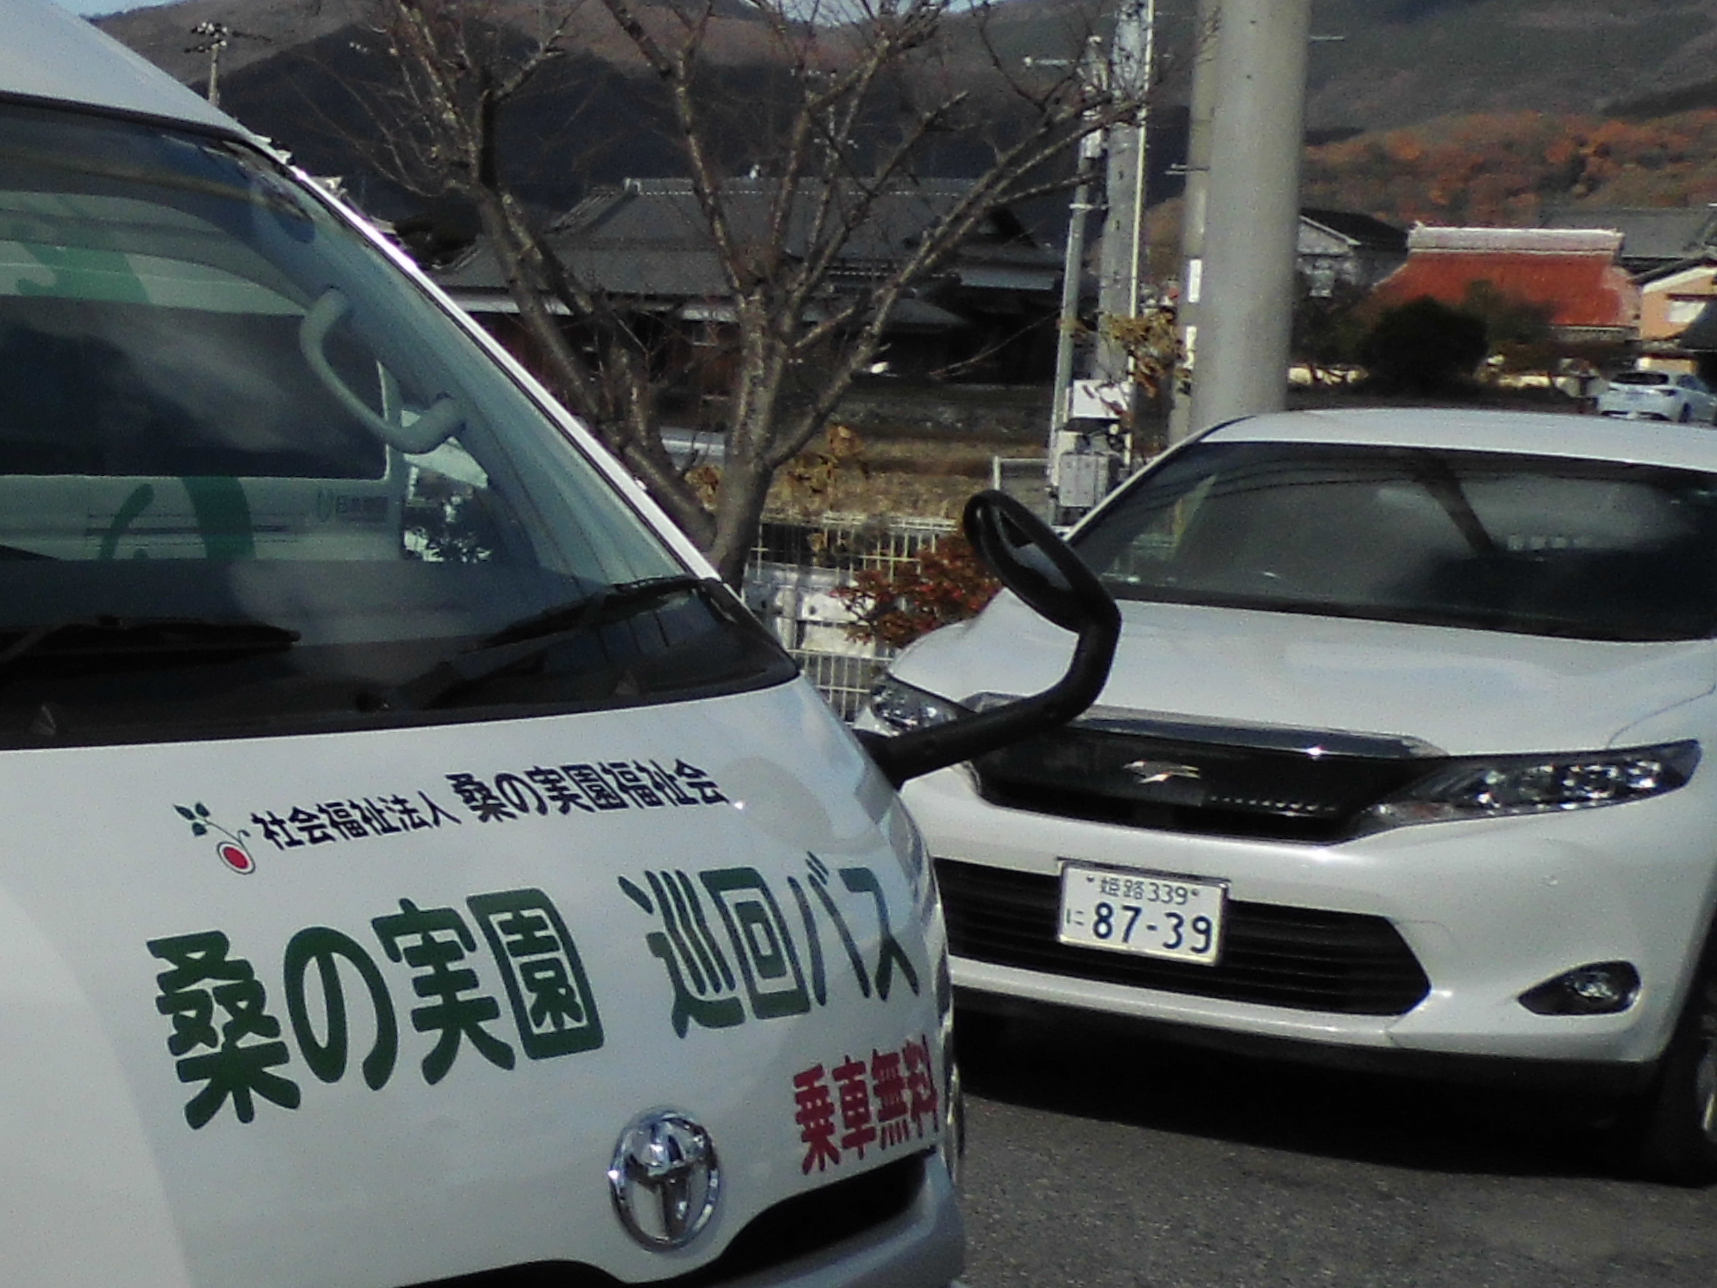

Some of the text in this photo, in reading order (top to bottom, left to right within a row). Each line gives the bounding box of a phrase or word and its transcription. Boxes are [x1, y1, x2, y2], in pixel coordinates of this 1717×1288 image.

[251, 758, 730, 851] 社会福祉法人 桑の実園福祉会
[1066, 902, 1212, 954] に 87-39
[146, 851, 920, 1130] 桑の実園 巡回バス
[793, 1034, 939, 1176] 乗車無料
